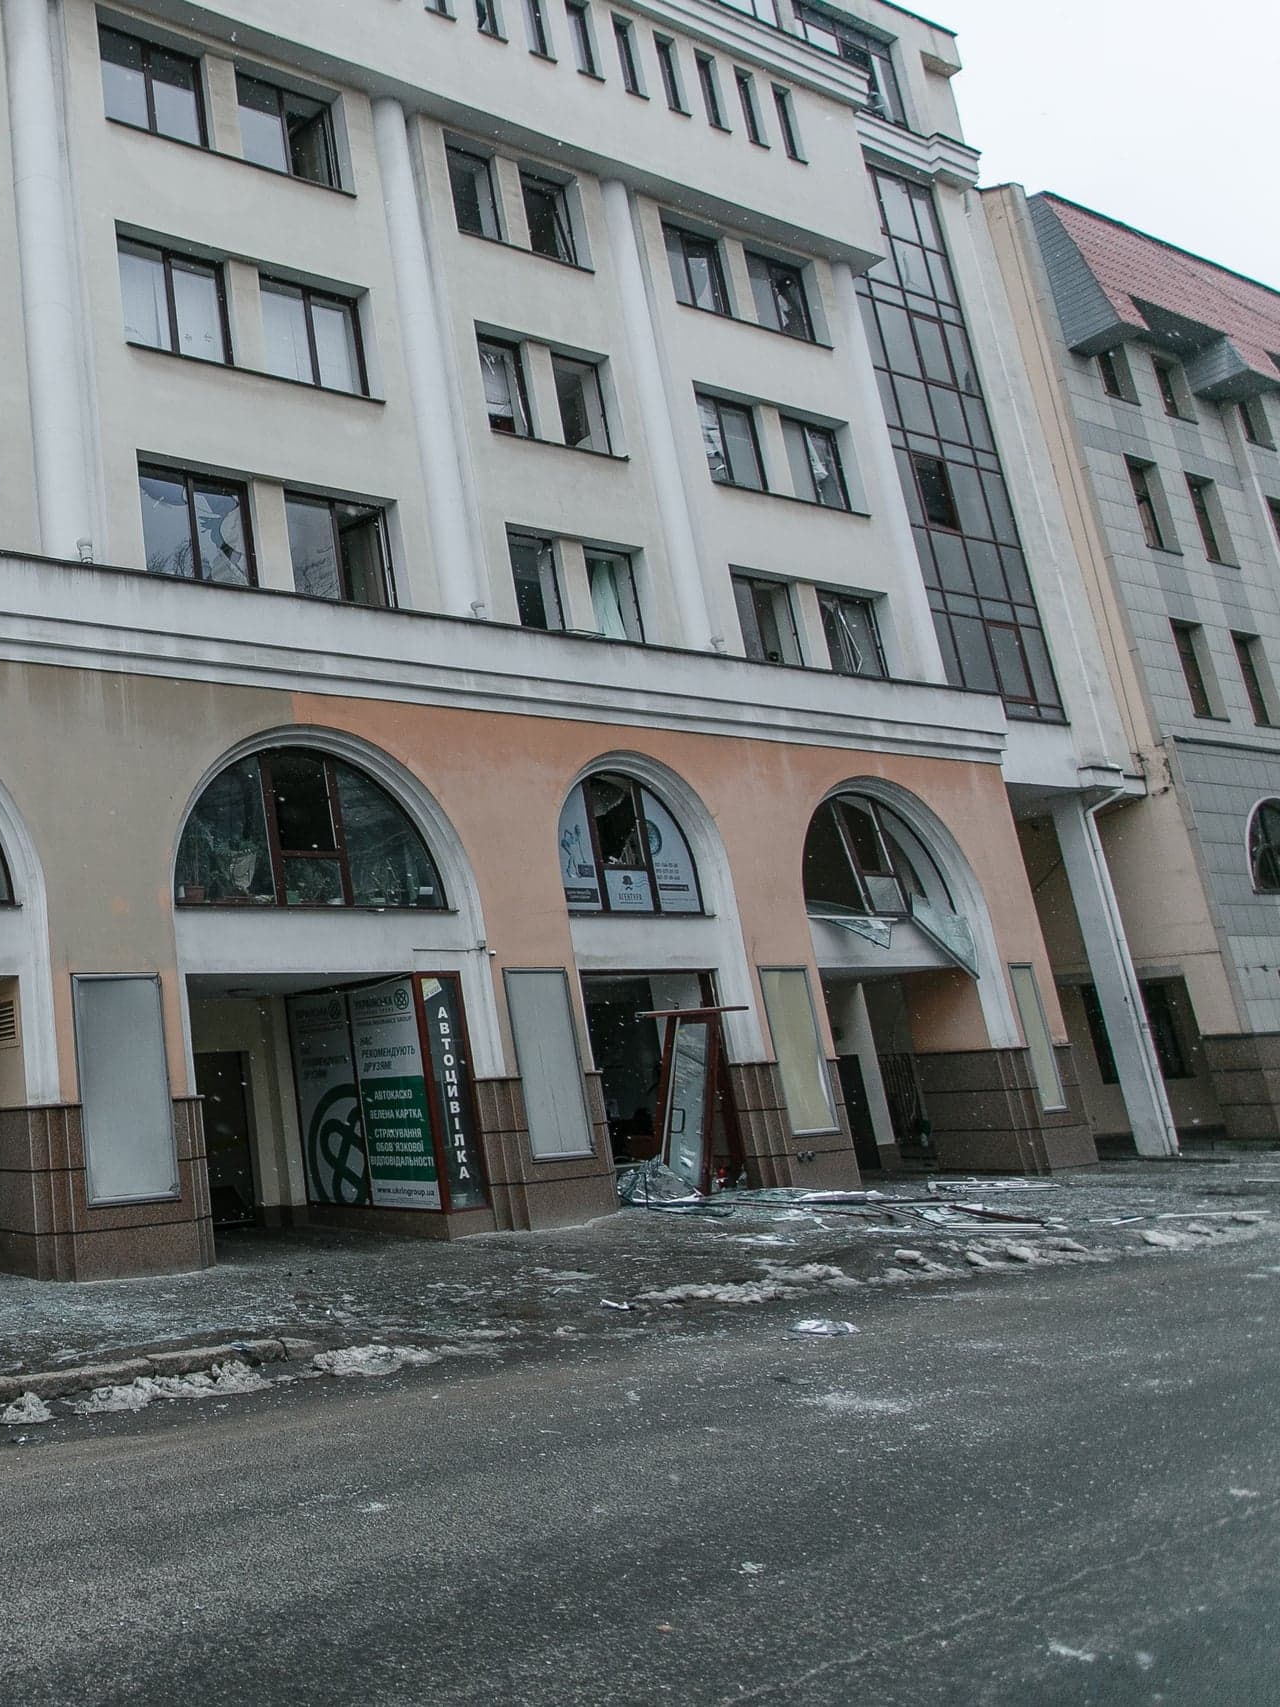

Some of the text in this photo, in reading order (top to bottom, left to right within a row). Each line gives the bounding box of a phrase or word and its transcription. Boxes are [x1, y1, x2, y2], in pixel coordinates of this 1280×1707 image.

[362, 1045, 416, 1059] РЕКОМЕНДУЮТЬ
[374, 1089, 413, 1100] АВТОКАСКО
[437, 1006, 470, 1179] АВТОЦИВІЛКА
[370, 1108, 423, 1120] ЗЕЛЕНА КАРТКА
[374, 1127, 422, 1139] СТРАХУВАННЯ
[370, 1155, 434, 1168] ВІДПОВІДАЛЬНОСТІ
